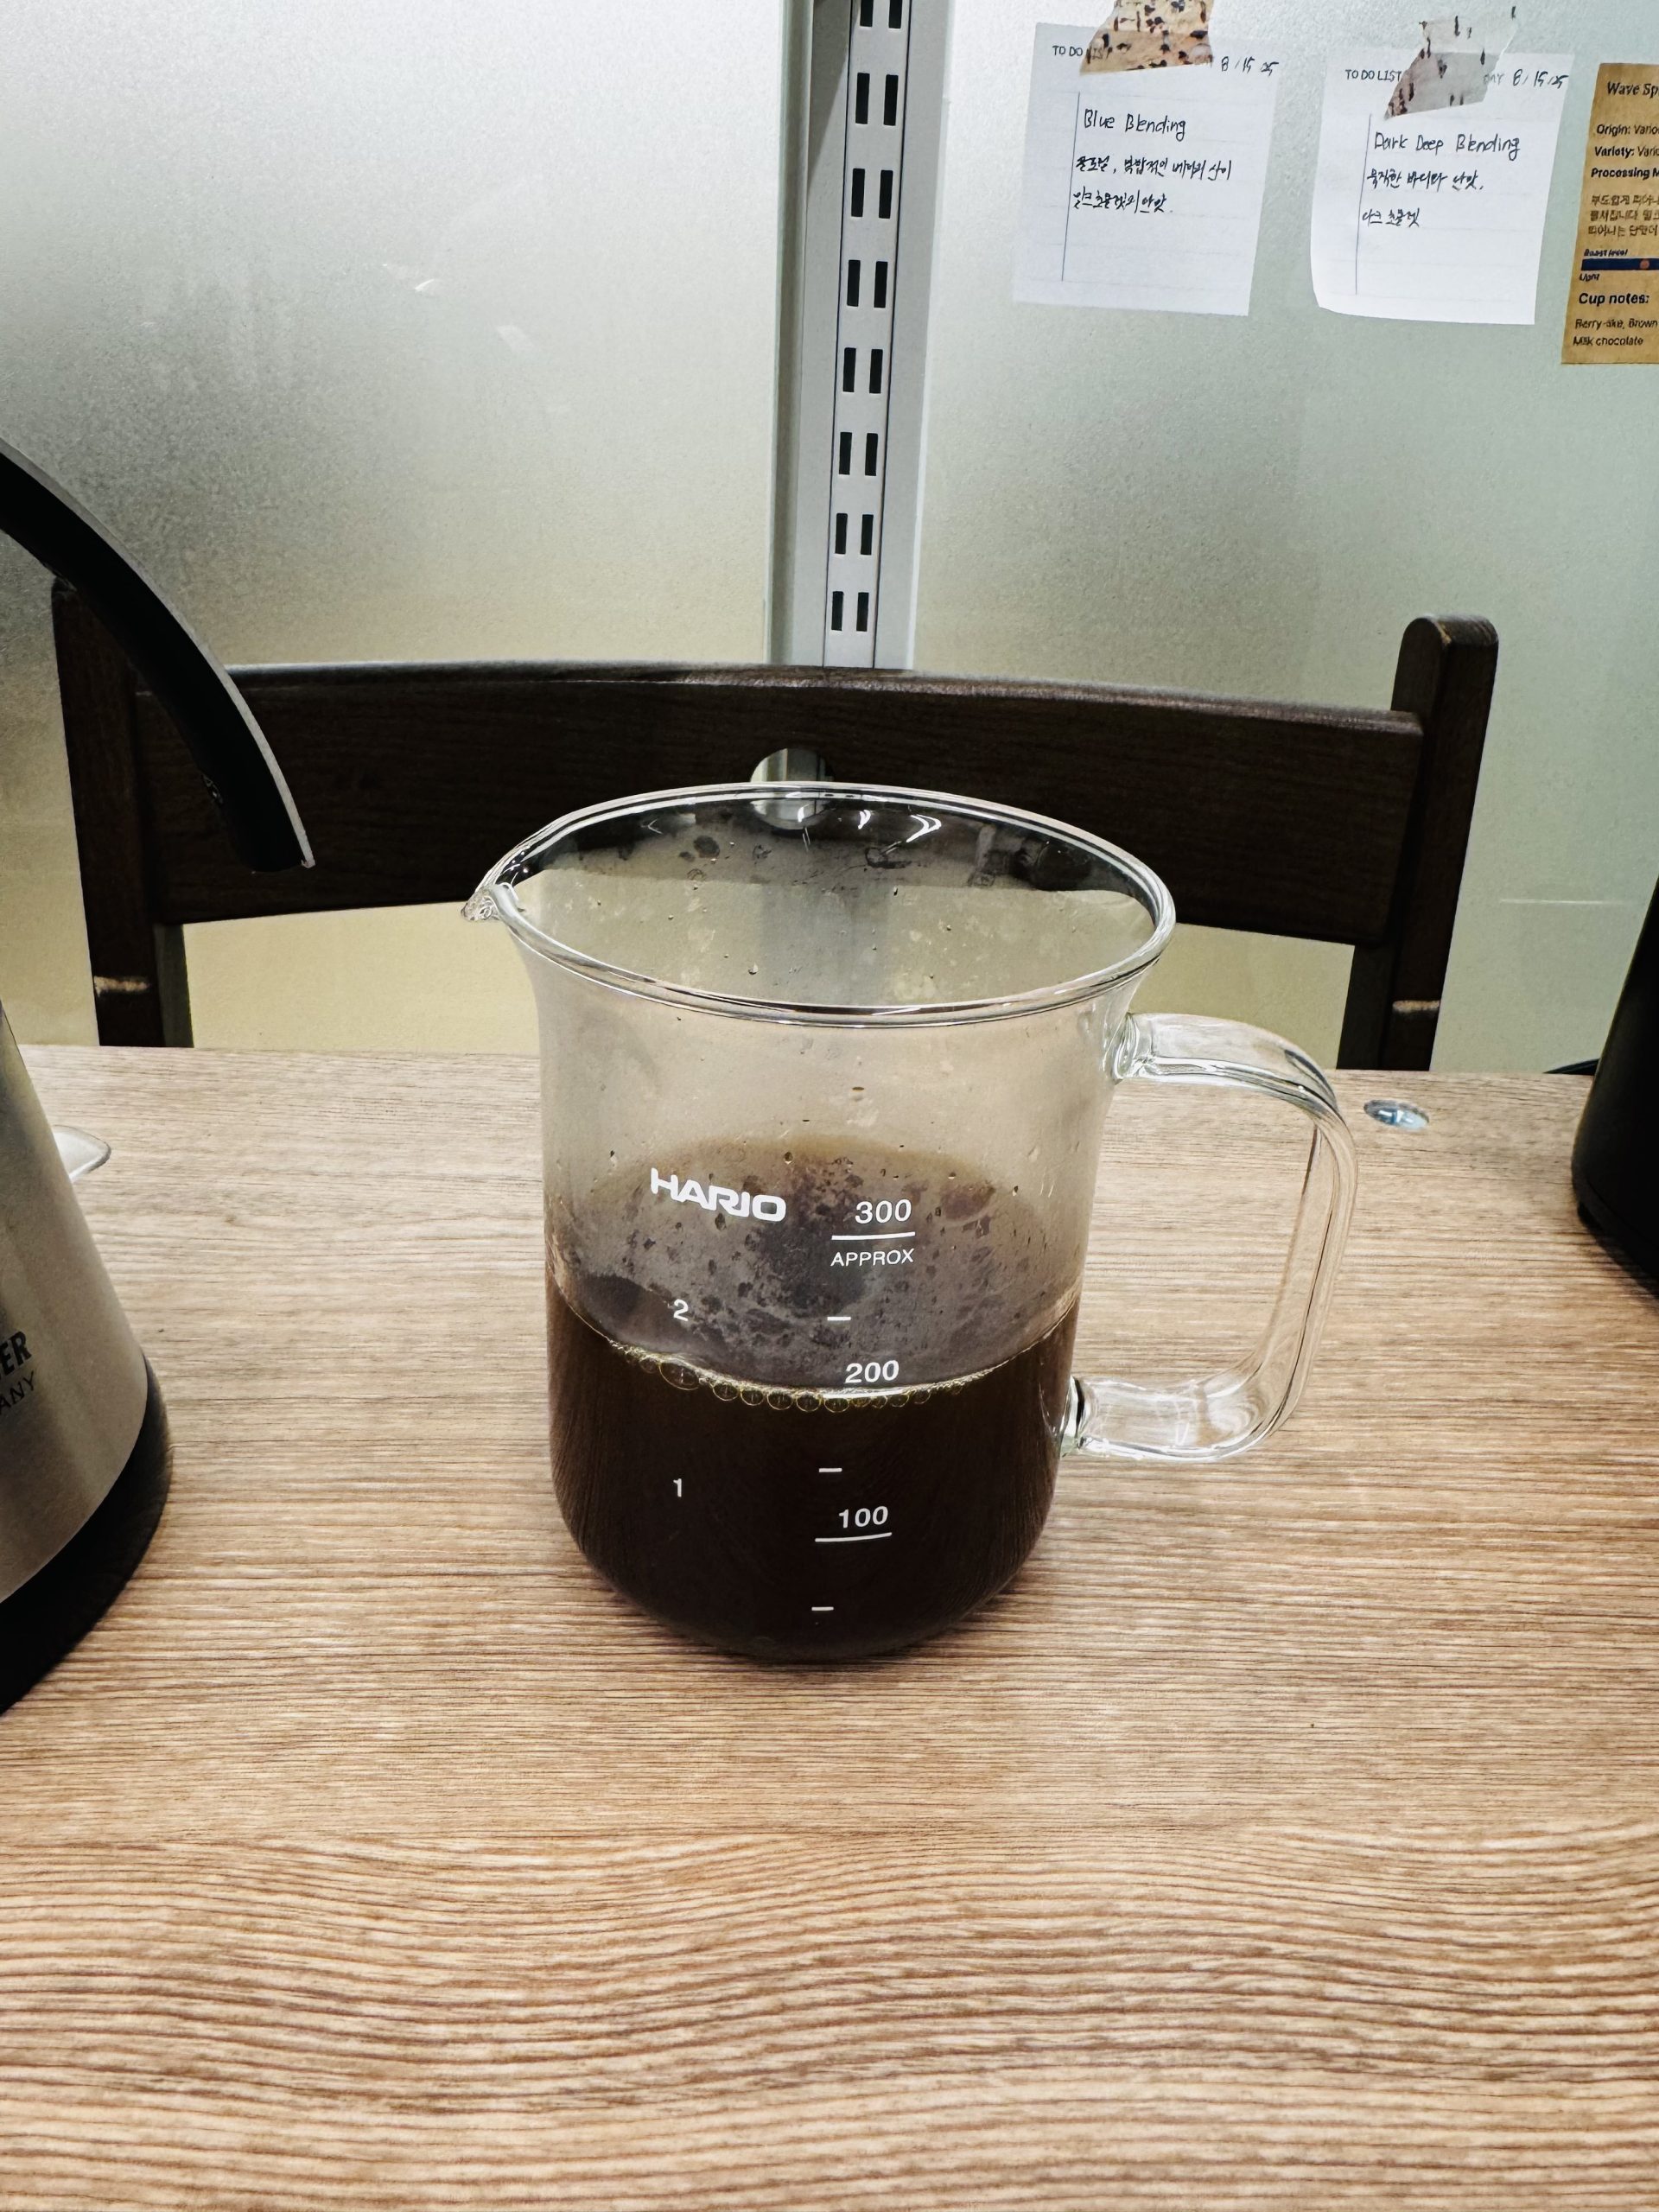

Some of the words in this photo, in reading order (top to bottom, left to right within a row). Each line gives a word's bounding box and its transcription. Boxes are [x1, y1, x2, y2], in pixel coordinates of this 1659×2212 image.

[1052, 45, 1066, 56] TO
[1069, 46, 1084, 57] DO
[1344, 69, 1359, 79] TO
[1361, 69, 1376, 79] DO
[1376, 69, 1402, 82] LIST
[1607, 81, 1640, 96] Wave
[1084, 108, 1116, 129] Blue
[1124, 113, 1186, 142] Blending
[1596, 124, 1631, 137] Origin:
[1374, 131, 1408, 150] Dark
[1415, 134, 1444, 156] Deep
[1456, 133, 1521, 162] Blending
[1591, 167, 1649, 181] Processing
[1579, 293, 1605, 307] Cup
[1609, 293, 1649, 304] notes:
[1629, 318, 1658, 328] Brown
[1573, 336, 1593, 346] Milk
[1596, 336, 1643, 346] chocolate
[651, 1167, 786, 1222] HARIO
[855, 1198, 912, 1224] 300
[830, 1249, 914, 1267] APPROX
[672, 1299, 689, 1322] 2
[844, 1360, 899, 1383] 200
[673, 1478, 683, 1497] 1
[838, 1506, 889, 1529] 100
